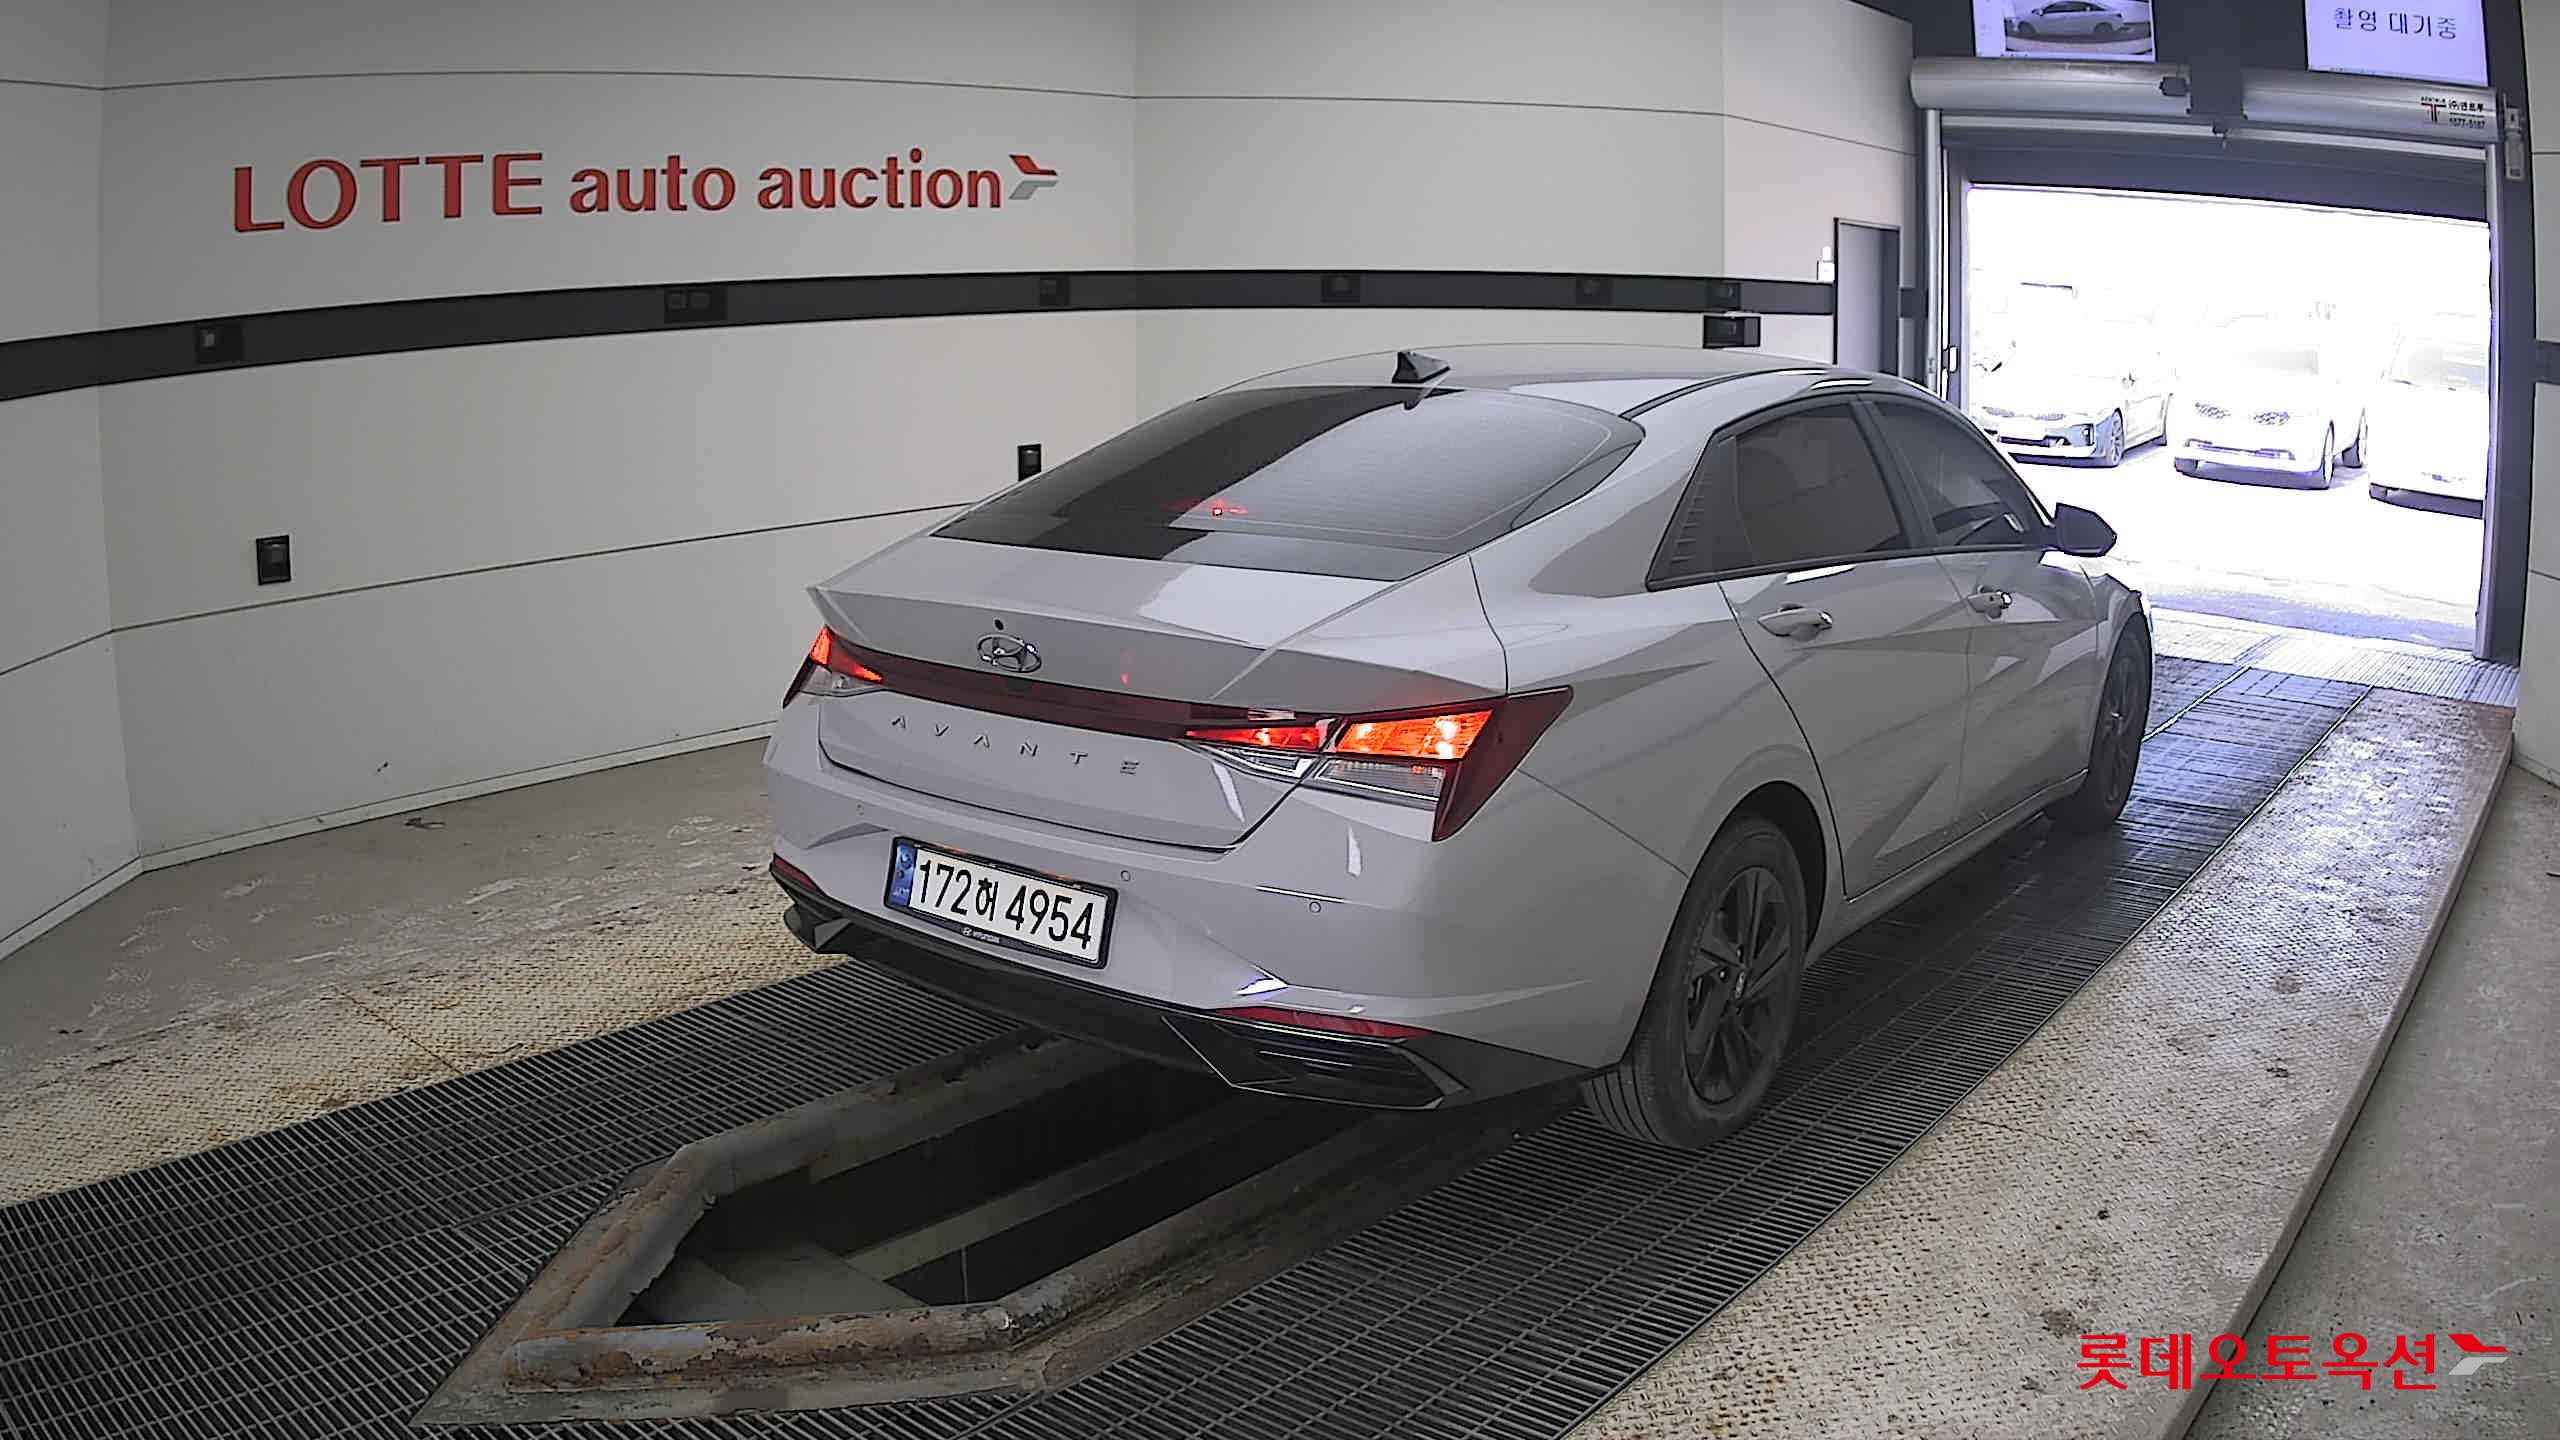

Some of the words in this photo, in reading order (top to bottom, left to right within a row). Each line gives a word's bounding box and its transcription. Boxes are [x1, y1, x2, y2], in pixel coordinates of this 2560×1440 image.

[2389, 12, 2457, 40] 대기중
[234, 152, 543, 233] LOTTE
[569, 155, 737, 214] auto
[757, 147, 1002, 209] auction
[891, 715, 1140, 776] AVANTE
[1005, 885, 1094, 950] 4954
